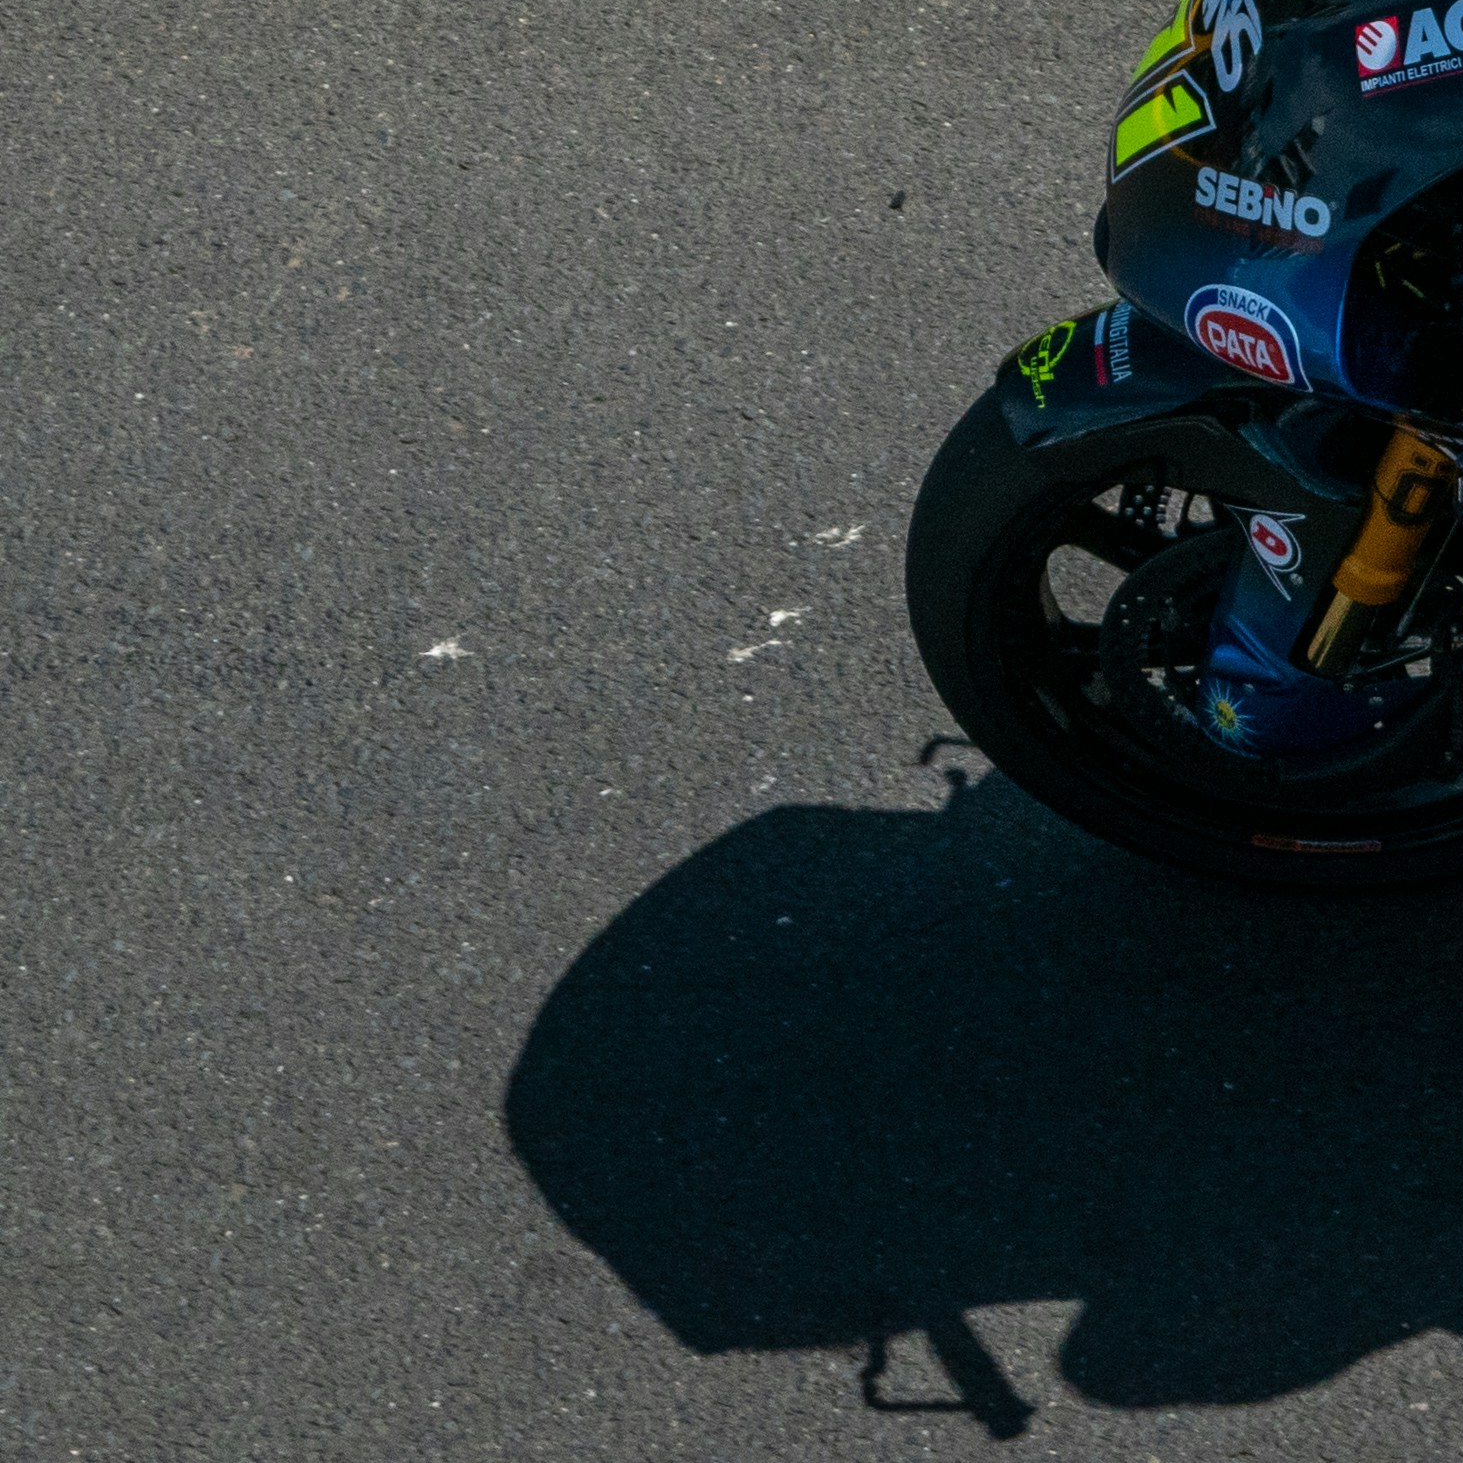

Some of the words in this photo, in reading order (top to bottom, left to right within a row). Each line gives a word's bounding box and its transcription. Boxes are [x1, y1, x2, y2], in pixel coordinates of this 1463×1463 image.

[1361, 71, 1406, 93] IMPIANTI
[1407, 56, 1463, 81] ELETTRICI
[1219, 289, 1269, 323] SNACK
[1207, 319, 1282, 376] PATA
